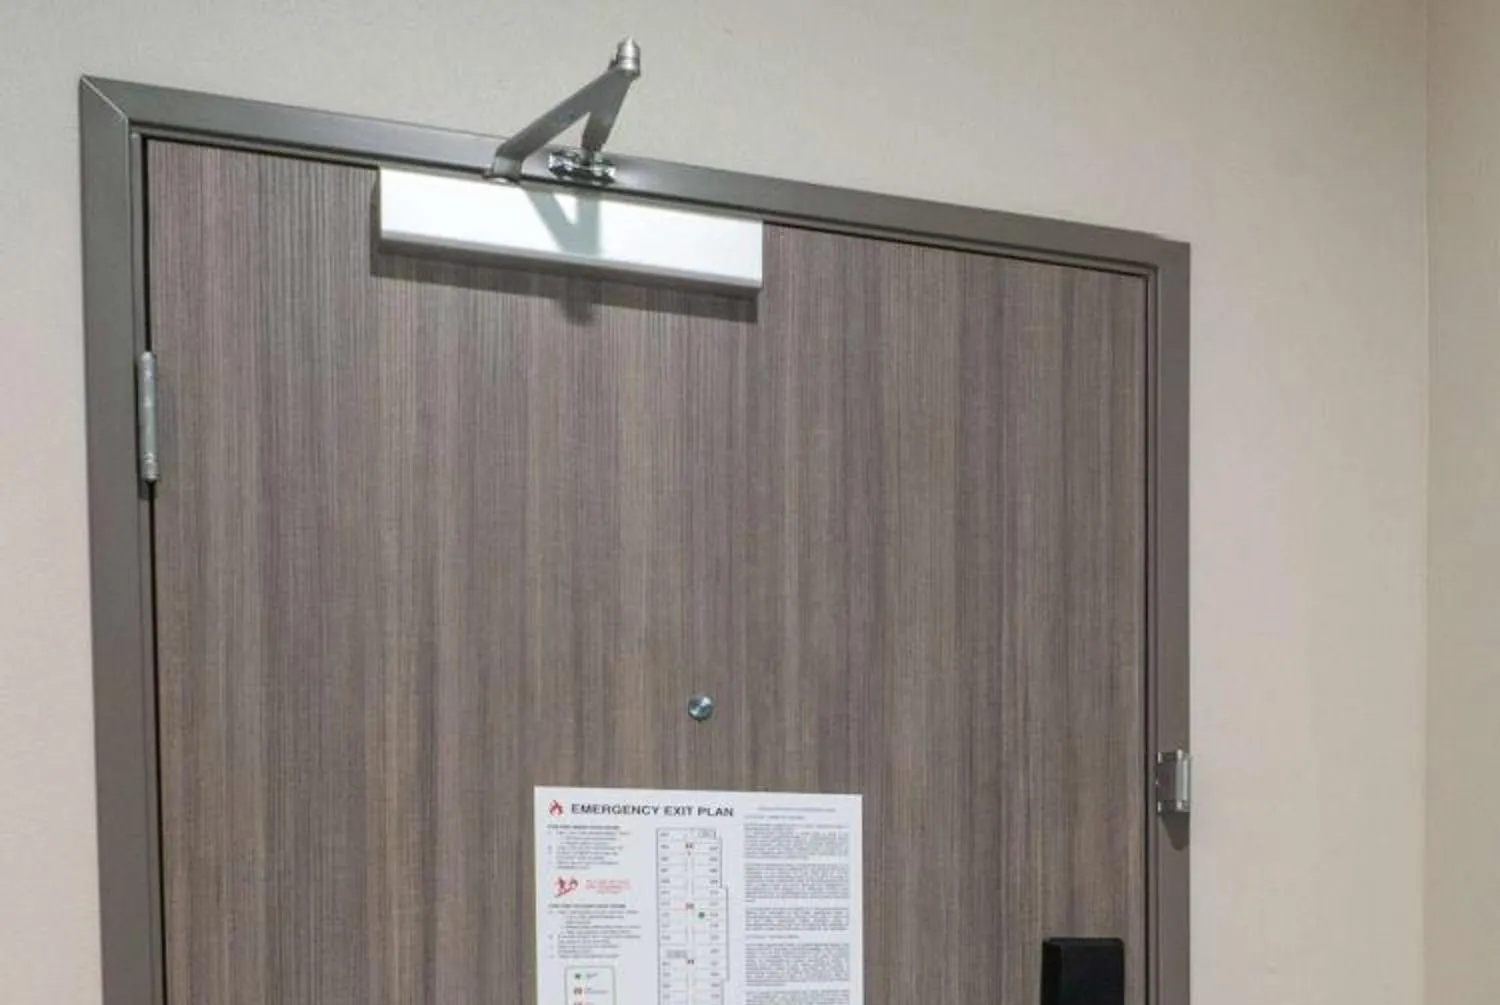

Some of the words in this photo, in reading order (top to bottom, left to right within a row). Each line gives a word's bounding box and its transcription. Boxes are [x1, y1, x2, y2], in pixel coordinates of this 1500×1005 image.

[571, 803, 659, 816] EMERGENCY
[663, 805, 694, 816] EXIT
[697, 806, 734, 817] PLAN
